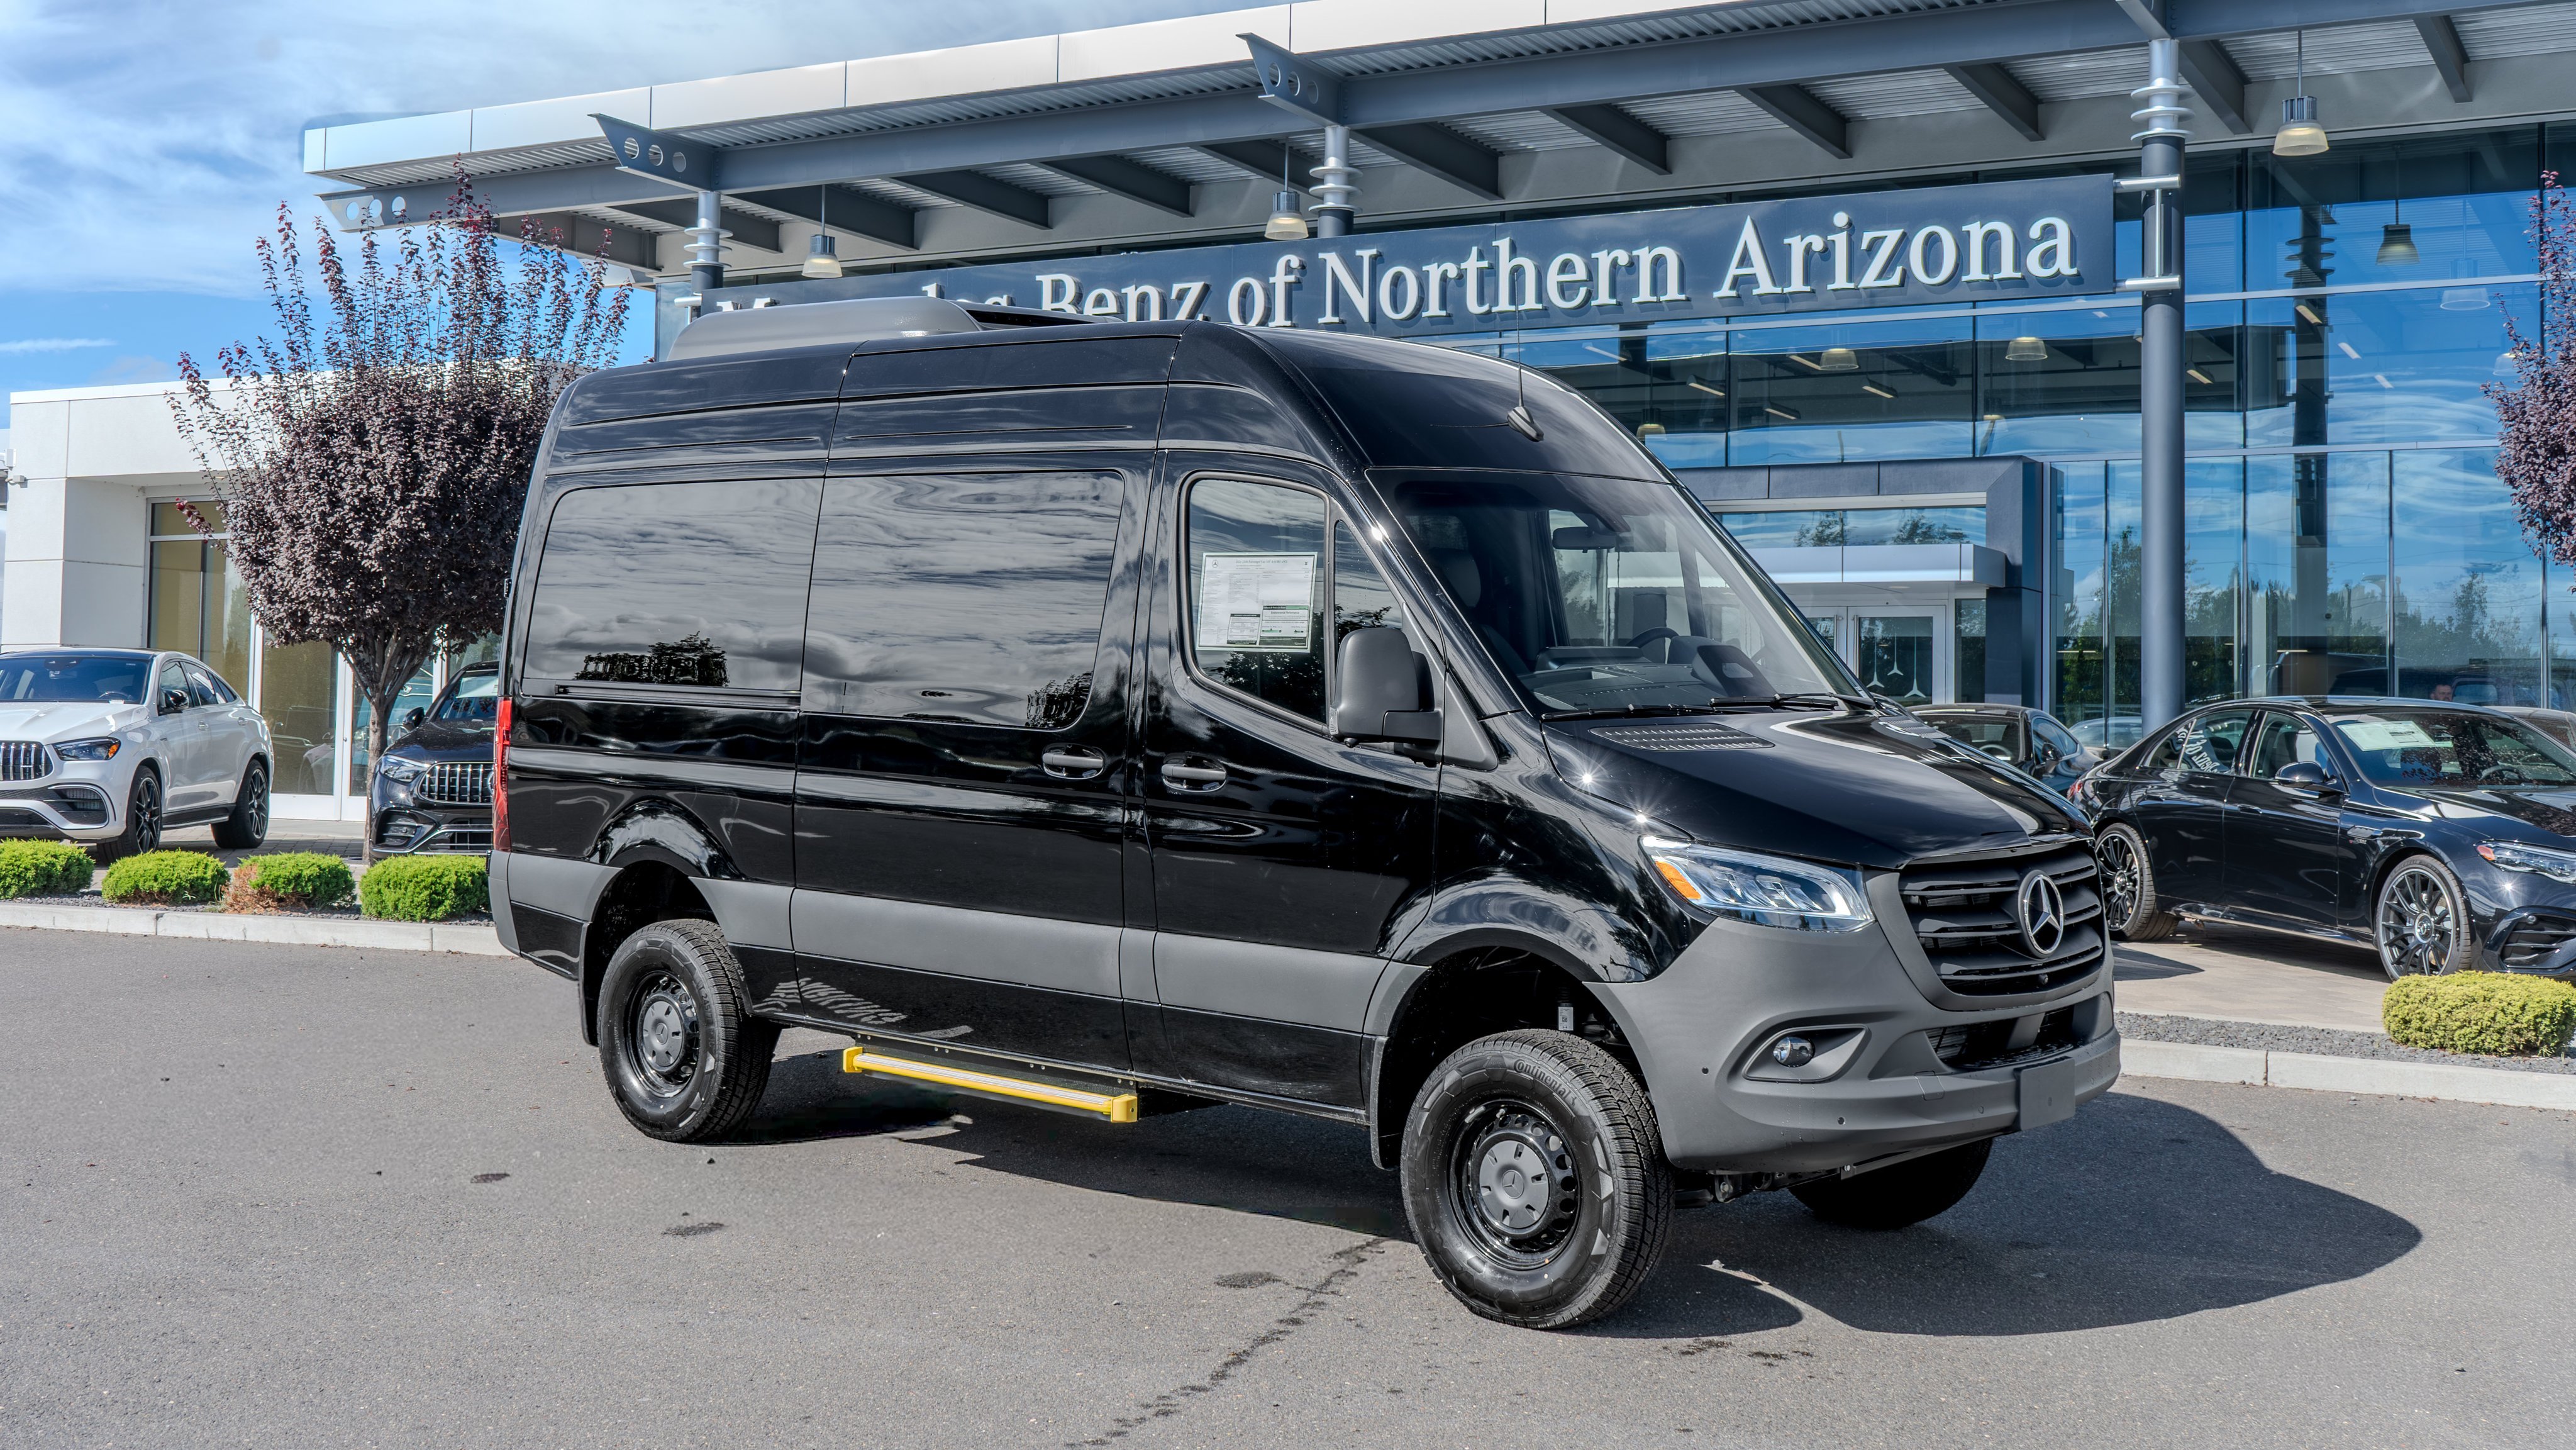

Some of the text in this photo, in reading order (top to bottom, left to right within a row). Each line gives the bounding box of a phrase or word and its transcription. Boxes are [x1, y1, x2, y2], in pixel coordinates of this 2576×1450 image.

[1228, 254, 1306, 326] of
[1318, 236, 1692, 324] Northern
[1713, 211, 2080, 299] Arizona
[1513, 1059, 1572, 1099] Continental
